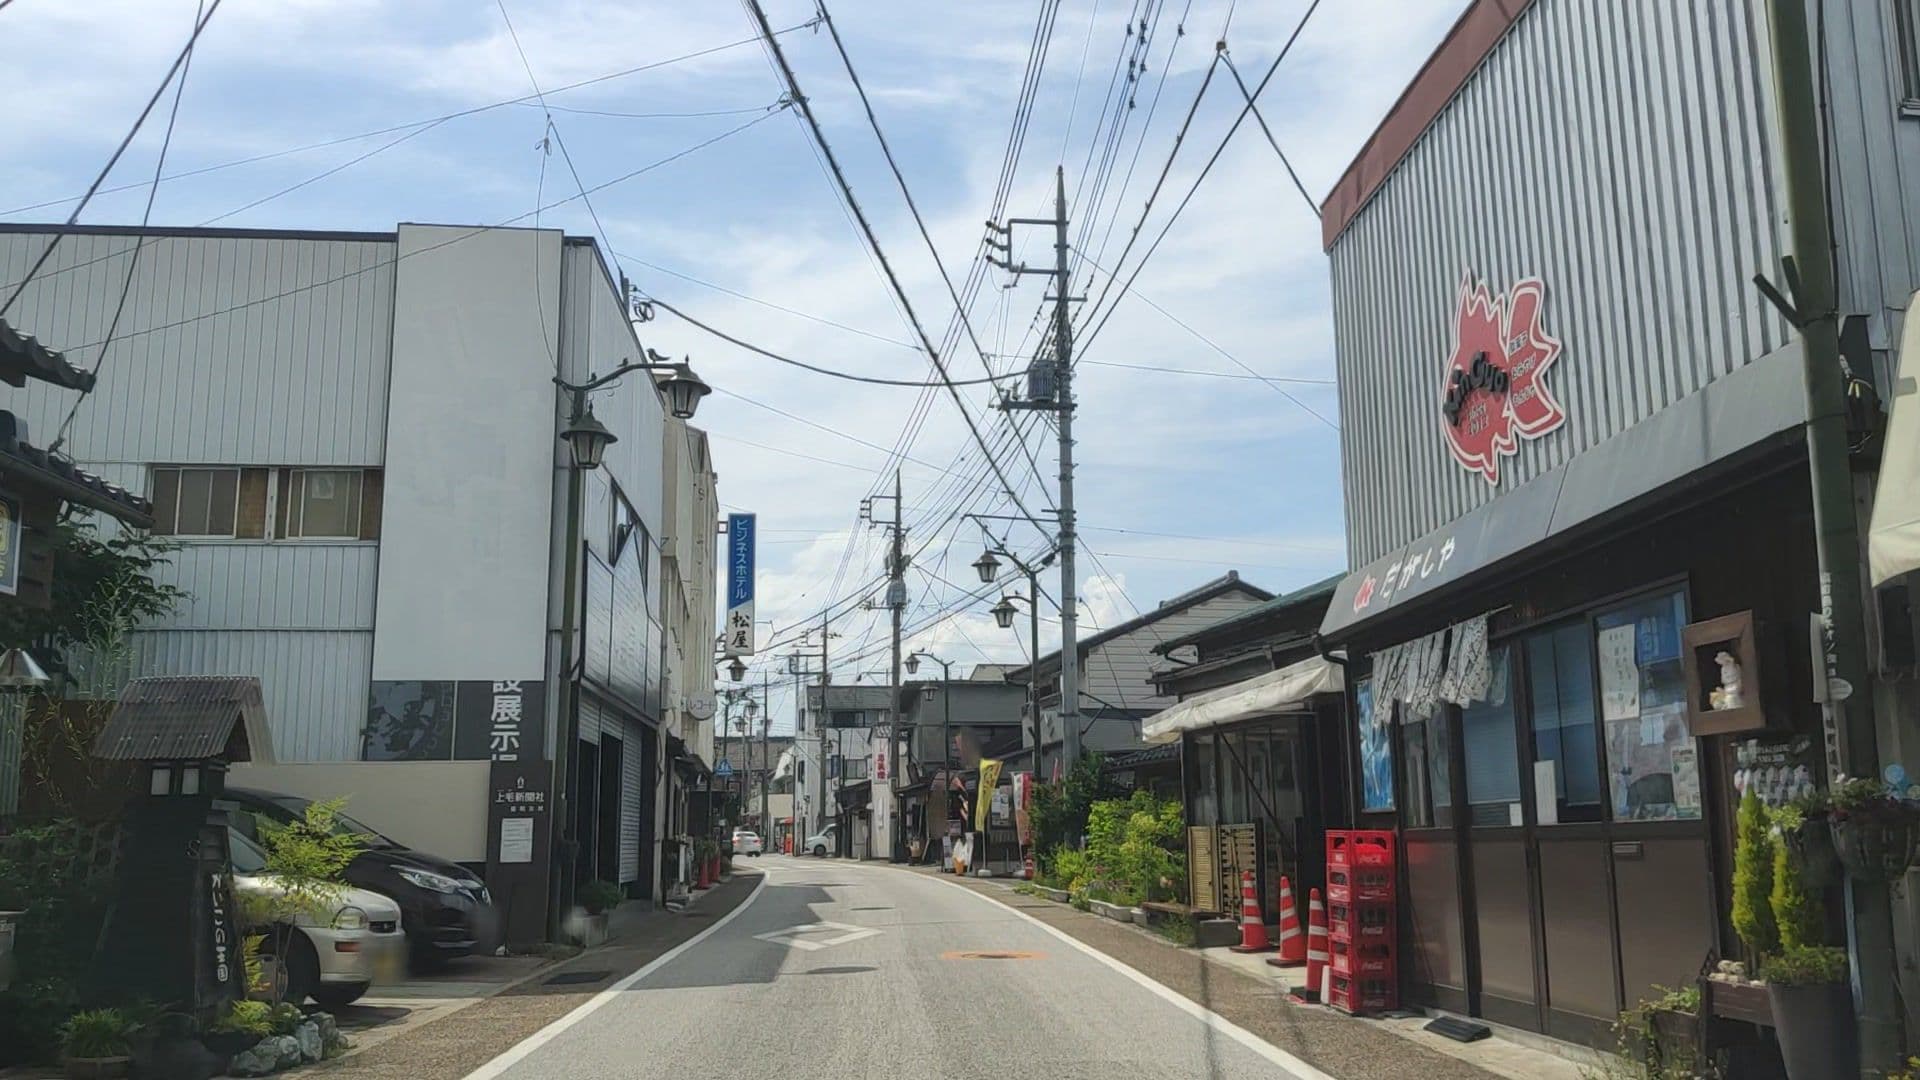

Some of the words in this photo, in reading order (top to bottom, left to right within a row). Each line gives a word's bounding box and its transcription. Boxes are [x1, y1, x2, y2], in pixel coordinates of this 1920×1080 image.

[735, 519, 748, 600] ビジネスホテル
[1380, 536, 1455, 598] だがしや
[731, 611, 750, 649] 松屋
[495, 791, 544, 803] 上毛新聞社
